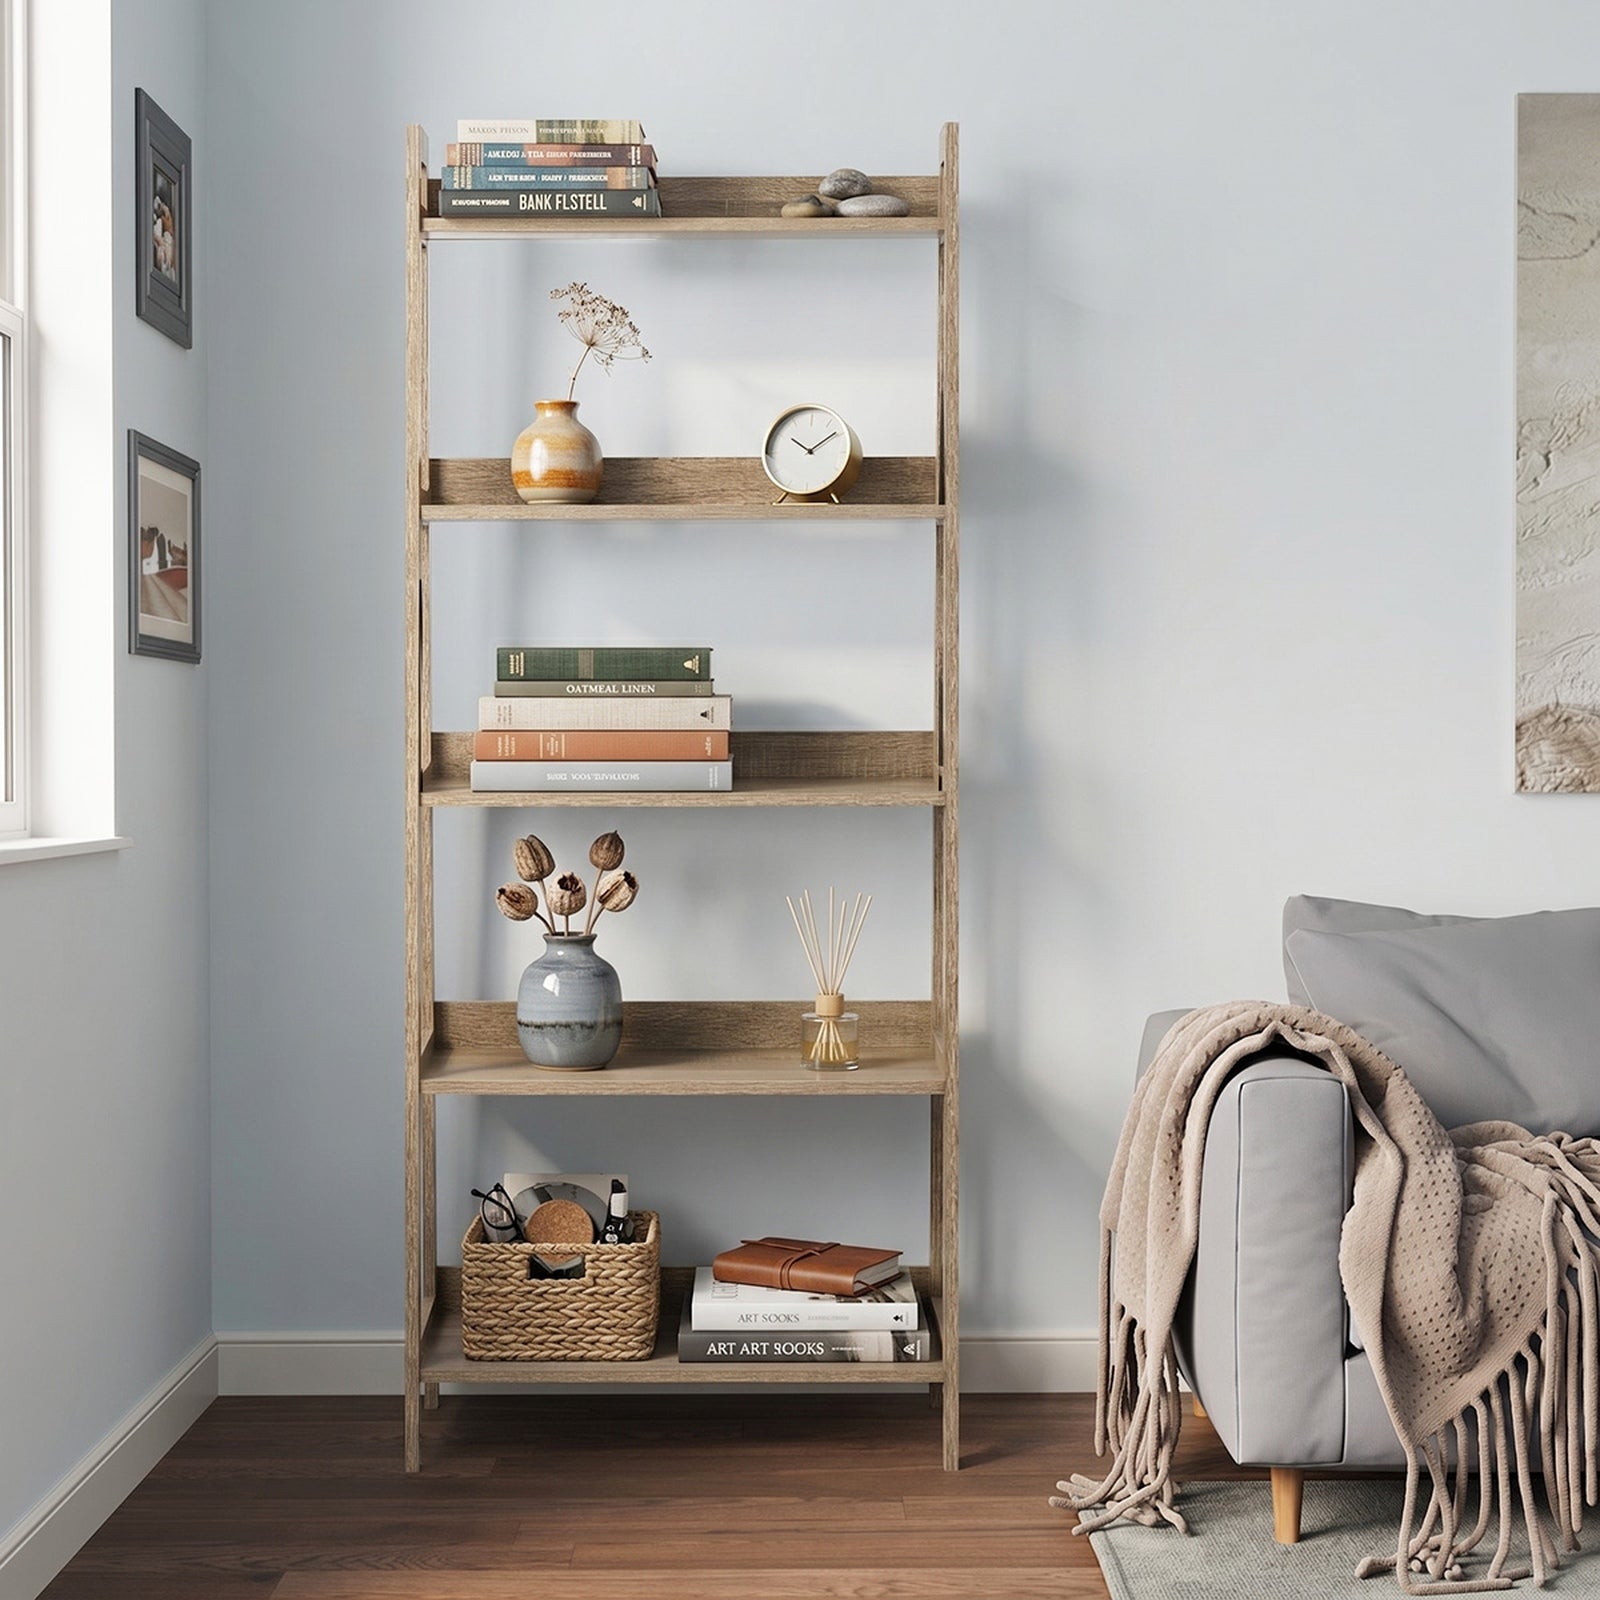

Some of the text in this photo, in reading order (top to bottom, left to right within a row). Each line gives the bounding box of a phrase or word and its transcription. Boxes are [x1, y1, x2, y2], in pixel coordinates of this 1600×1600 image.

[519, 194, 552, 210] BANK
[555, 194, 607, 210] FLSTELL
[566, 684, 656, 693] OATMEAL LINEN
[737, 1314, 759, 1323] ART
[706, 1342, 737, 1355] ART
[739, 1342, 770, 1355] ART
